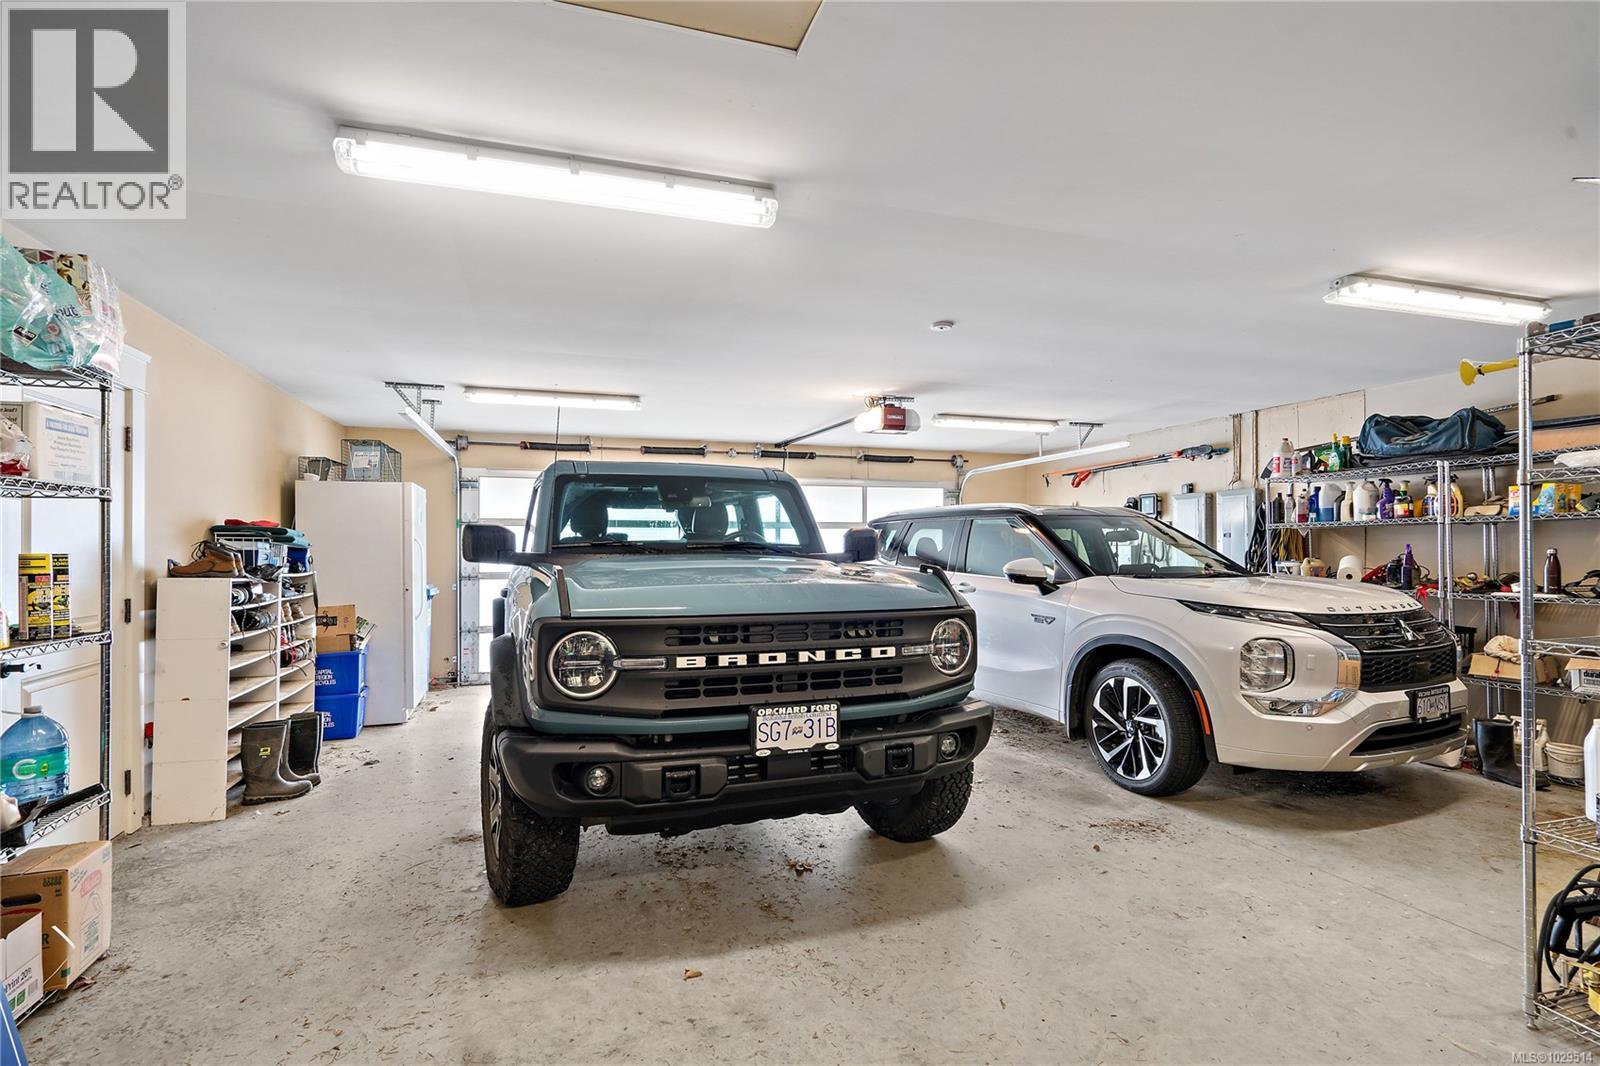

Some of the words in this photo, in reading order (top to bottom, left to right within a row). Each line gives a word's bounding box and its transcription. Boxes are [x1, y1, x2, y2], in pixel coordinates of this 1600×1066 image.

[676, 646, 895, 668] BRONCO
[757, 705, 808, 717] ORCHARD
[810, 703, 838, 712] FORD
[758, 719, 792, 743] SG7
[803, 716, 836, 739] 31B
